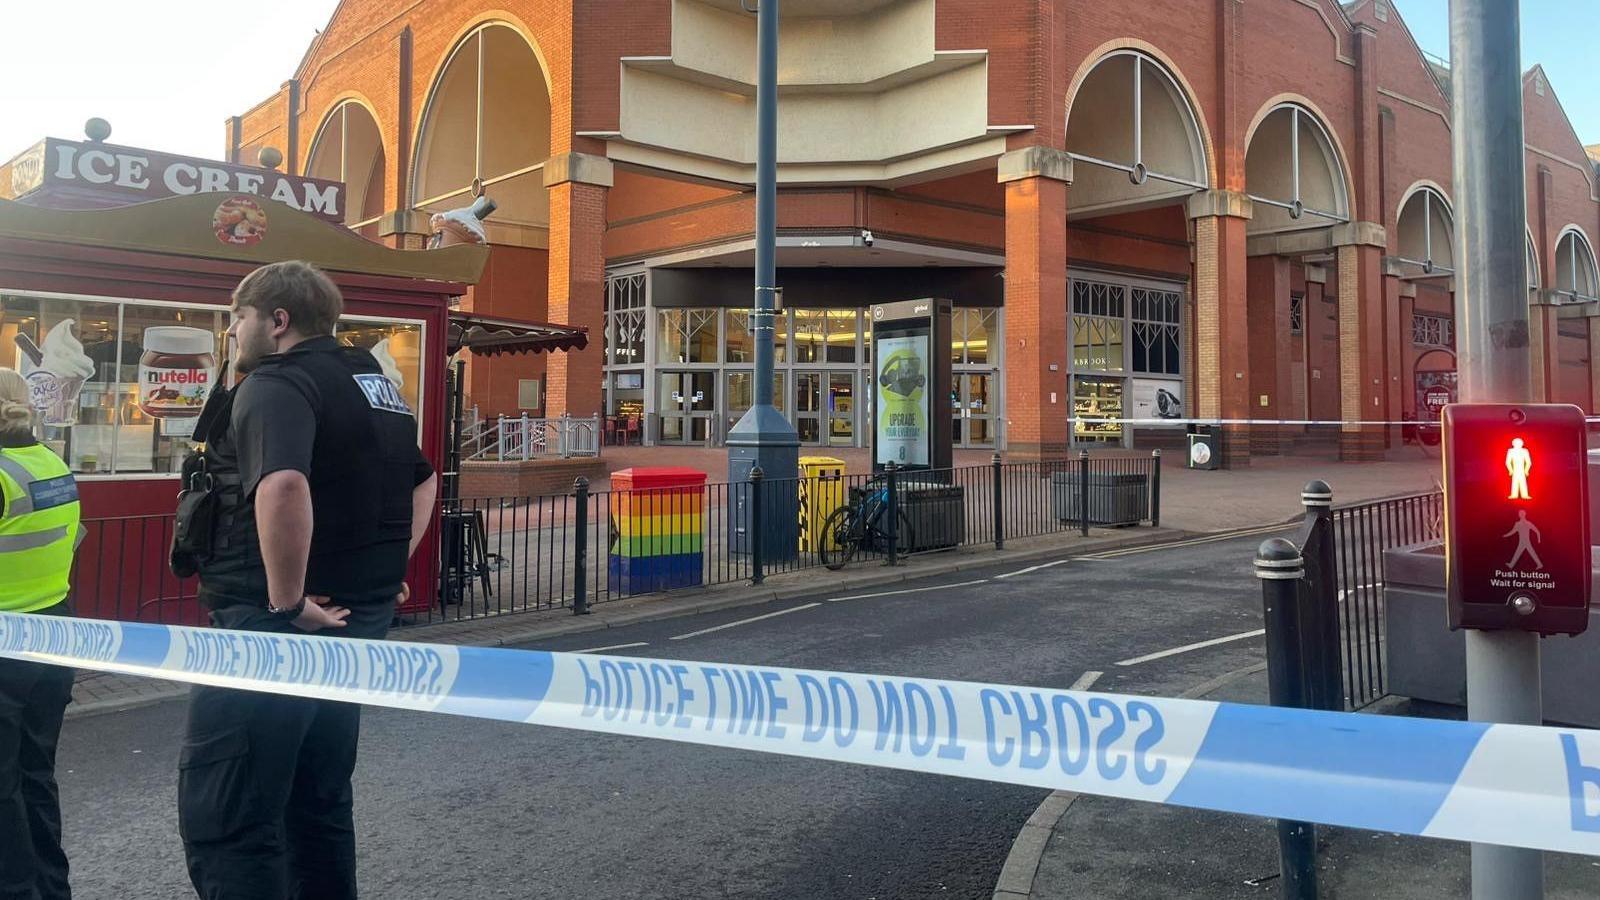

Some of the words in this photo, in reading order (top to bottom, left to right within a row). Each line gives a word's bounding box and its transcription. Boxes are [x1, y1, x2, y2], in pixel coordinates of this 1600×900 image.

[54, 145, 150, 190] ICE
[163, 163, 340, 215] CREAM
[148, 368, 208, 384] nutella
[1427, 398, 1449, 406] FREE
[1495, 570, 1518, 578] Push
[1520, 571, 1550, 580] button
[1490, 579, 1511, 587] Wait
[1512, 579, 1525, 588] for
[1527, 580, 1555, 590] signal
